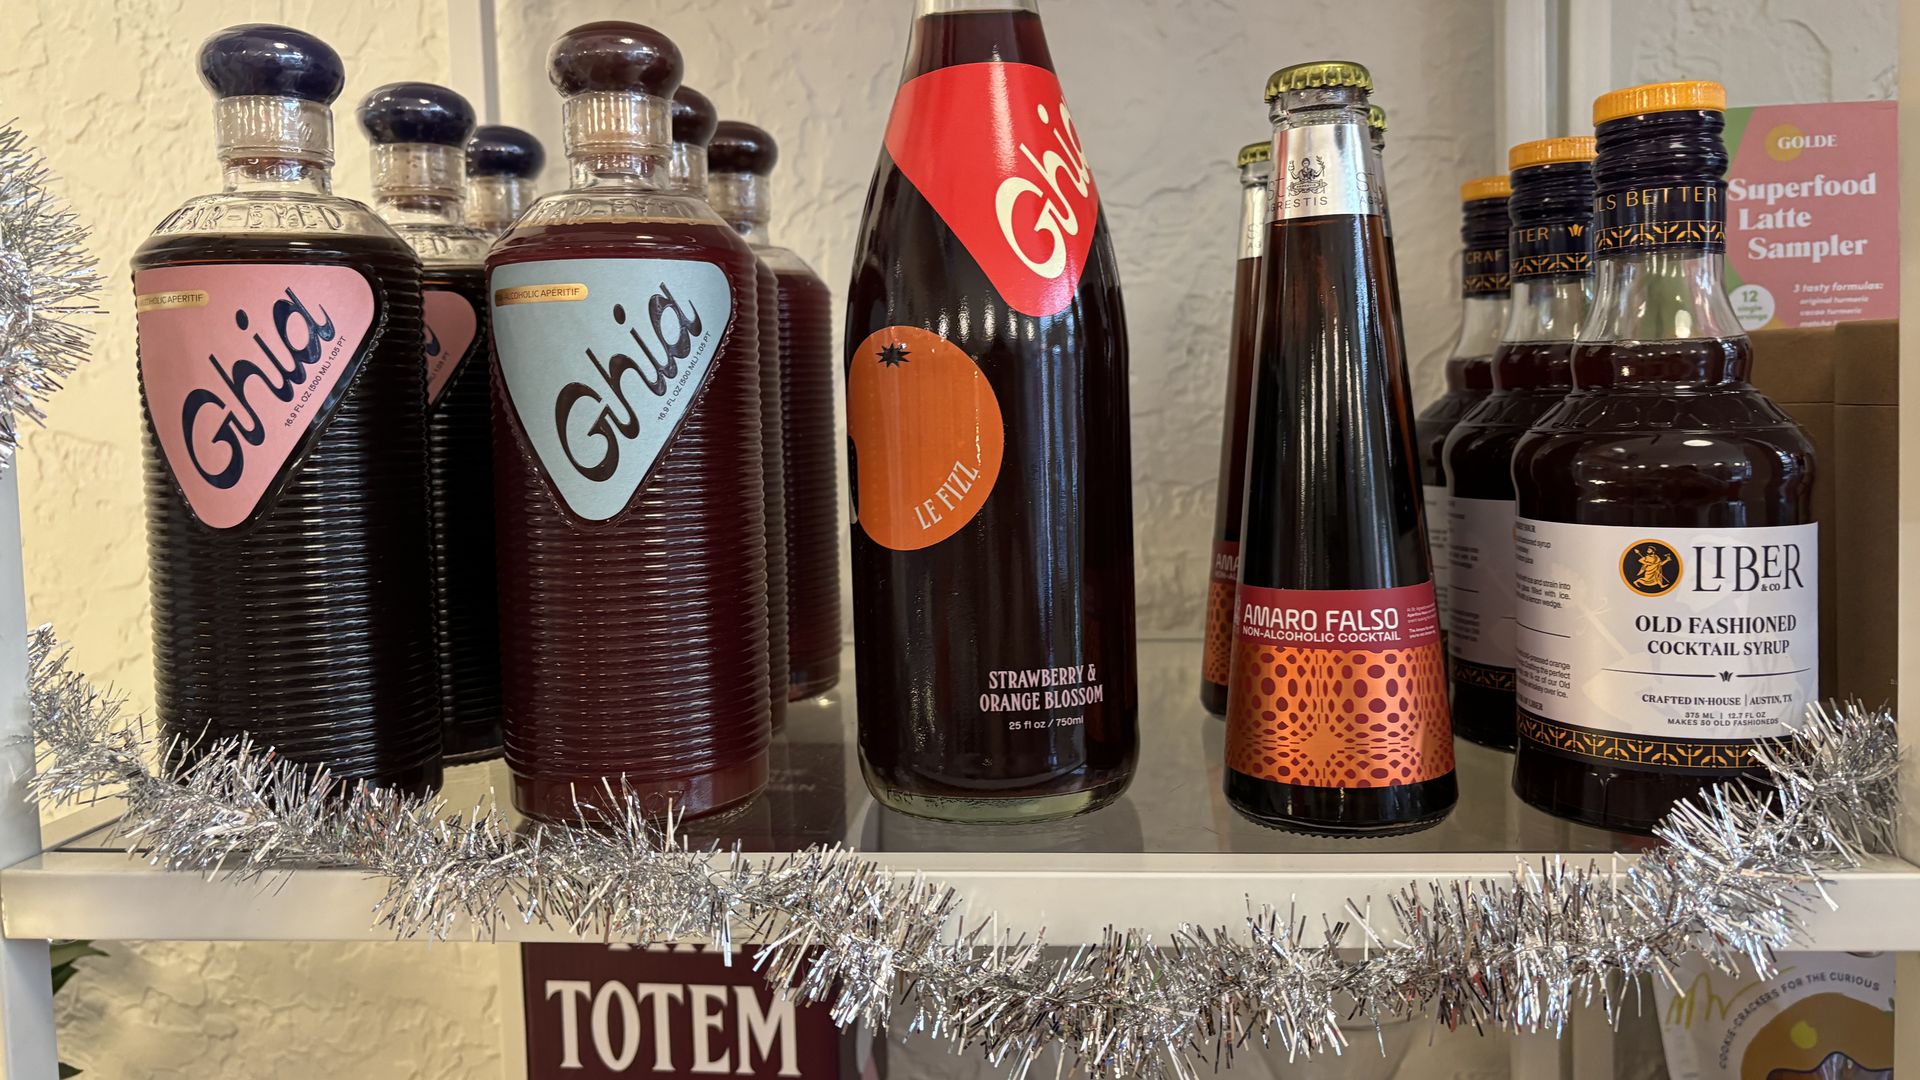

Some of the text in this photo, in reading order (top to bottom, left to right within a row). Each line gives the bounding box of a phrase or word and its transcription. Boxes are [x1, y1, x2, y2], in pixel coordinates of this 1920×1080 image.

[1777, 134, 1838, 150] GOLDE
[1626, 186, 1717, 208] BETTER
[1728, 172, 1877, 205] Superfood
[1738, 208, 1812, 231] Latte
[1747, 234, 1868, 263] Sampler
[167, 293, 205, 303] APERITIF
[540, 288, 580, 298] APERITIF
[1741, 290, 1758, 303] 12
[1792, 280, 1884, 294] 3 tasty formulas:
[284, 411, 298, 428] 16.9
[293, 402, 305, 414] FL
[301, 390, 312, 403] OZ
[309, 375, 322, 392] (500
[328, 346, 341, 361] 1.05
[336, 335, 347, 349] PT
[555, 281, 703, 483] Ghia
[657, 406, 670, 421] 16.9
[666, 397, 676, 408] FL
[672, 385, 683, 397] OZ
[679, 369, 691, 387] (500
[703, 330, 712, 344] PT
[182, 287, 336, 489] Ghia
[913, 460, 980, 530] LE FIZZ
[1215, 552, 1240, 571] AMA
[1691, 543, 1804, 592] LIBER
[1243, 603, 1318, 631] AMARO
[1325, 607, 1399, 632] FALSO
[1635, 614, 1797, 634] OLD FASHIONED
[1242, 625, 1335, 643] NON-ALCOHOLIC
[1337, 631, 1402, 643] COCKTAIL
[1647, 639, 1790, 656] COCKTAIL SYRUP
[988, 663, 1097, 690] STRAWBERRY &
[1558, 680, 1571, 690] Old
[979, 684, 1104, 712] ORANGE BLOSSOM
[1642, 693, 1793, 706] CRAFTED IN-HOUSE AUSTIN, TX
[1008, 720, 1022, 731] 25
[1023, 720, 1032, 730] fl
[1034, 721, 1046, 729] oz
[1055, 715, 1084, 727] 750ml
[1667, 718, 1698, 726] MAKES
[1713, 719, 1731, 727] OLD
[1733, 717, 1780, 727] FASHIONEDS
[1685, 711, 1700, 719] 375
[1756, 711, 1767, 719] OZ
[1780, 978, 1804, 993] FOR
[1805, 972, 1826, 985] THE
[1829, 971, 1881, 992] CURIOUS
[545, 979, 803, 1077] TOTEM
